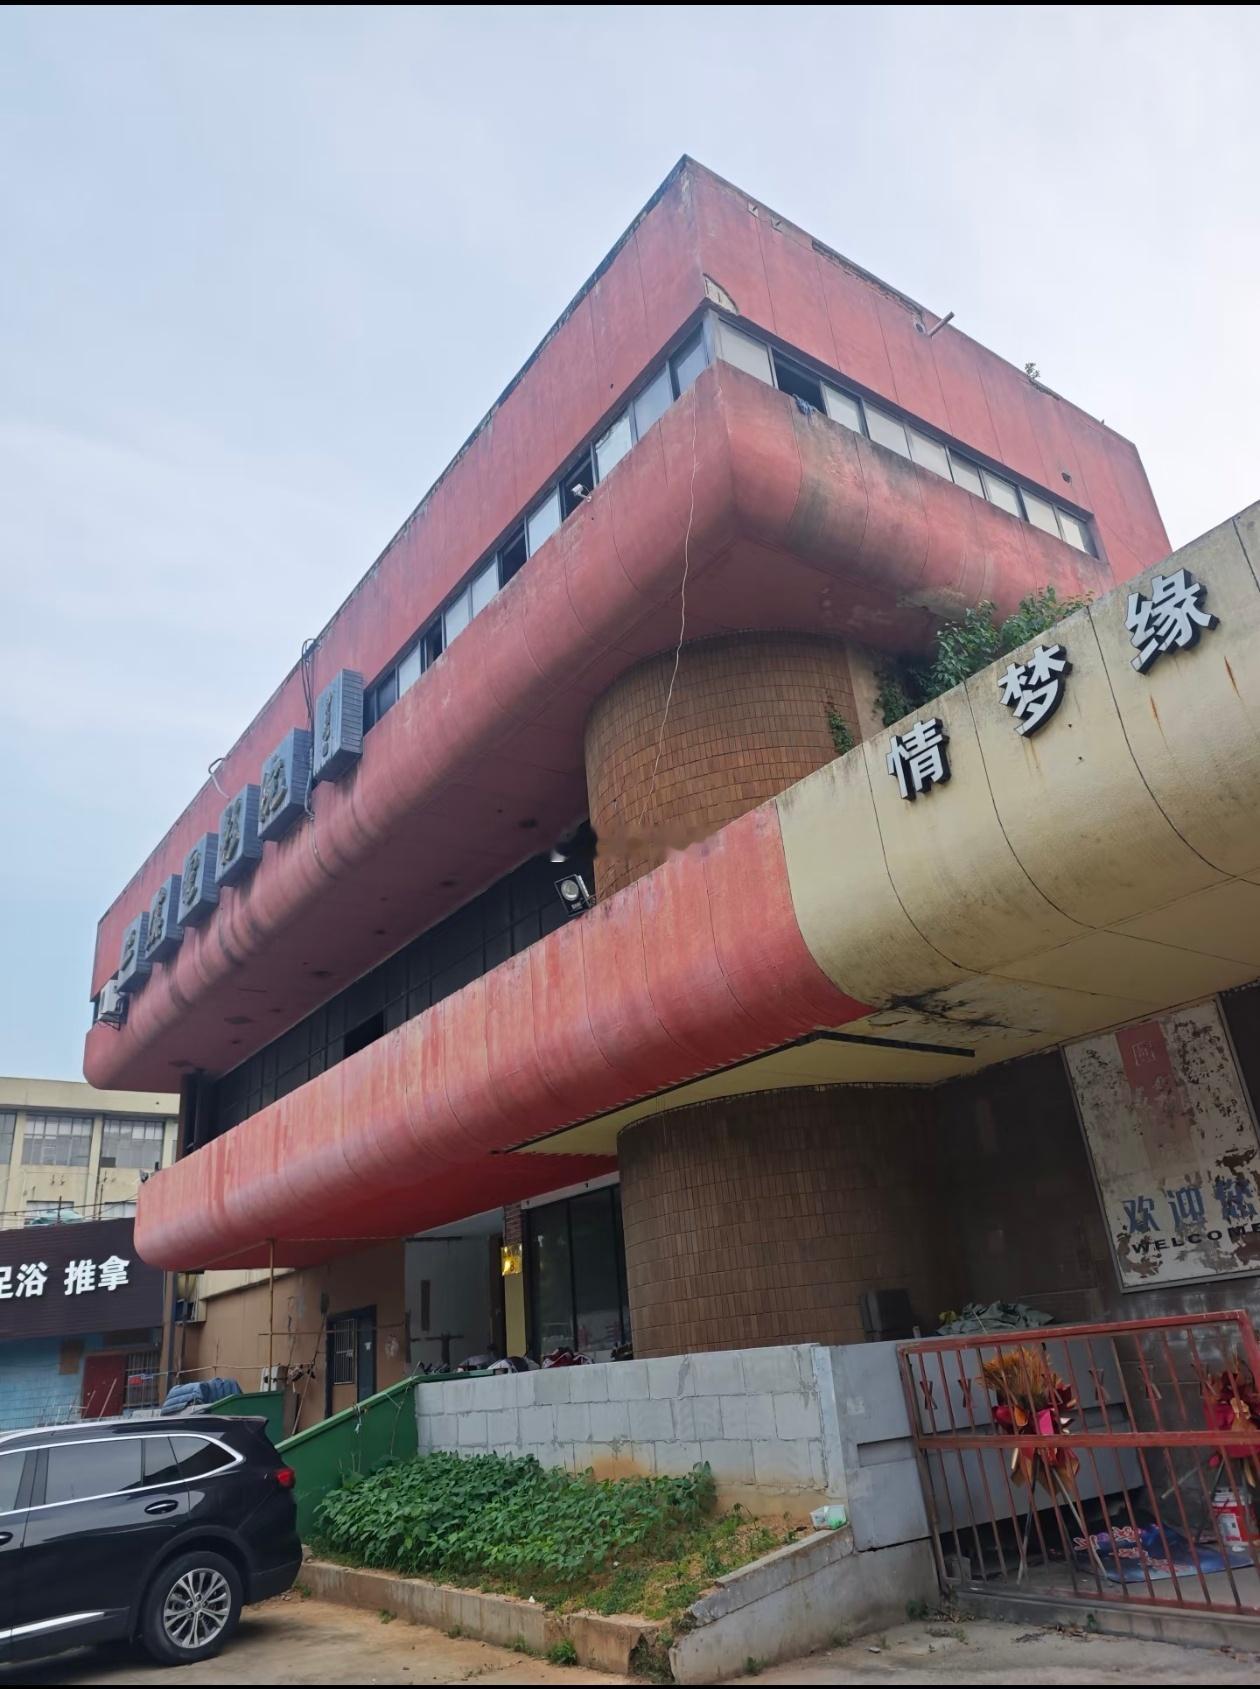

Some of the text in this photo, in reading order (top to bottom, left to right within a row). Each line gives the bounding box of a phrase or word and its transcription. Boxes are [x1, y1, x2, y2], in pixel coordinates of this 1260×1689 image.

[886, 567, 1219, 801] 情梦缘
[64, 1255, 129, 1295] 推拿
